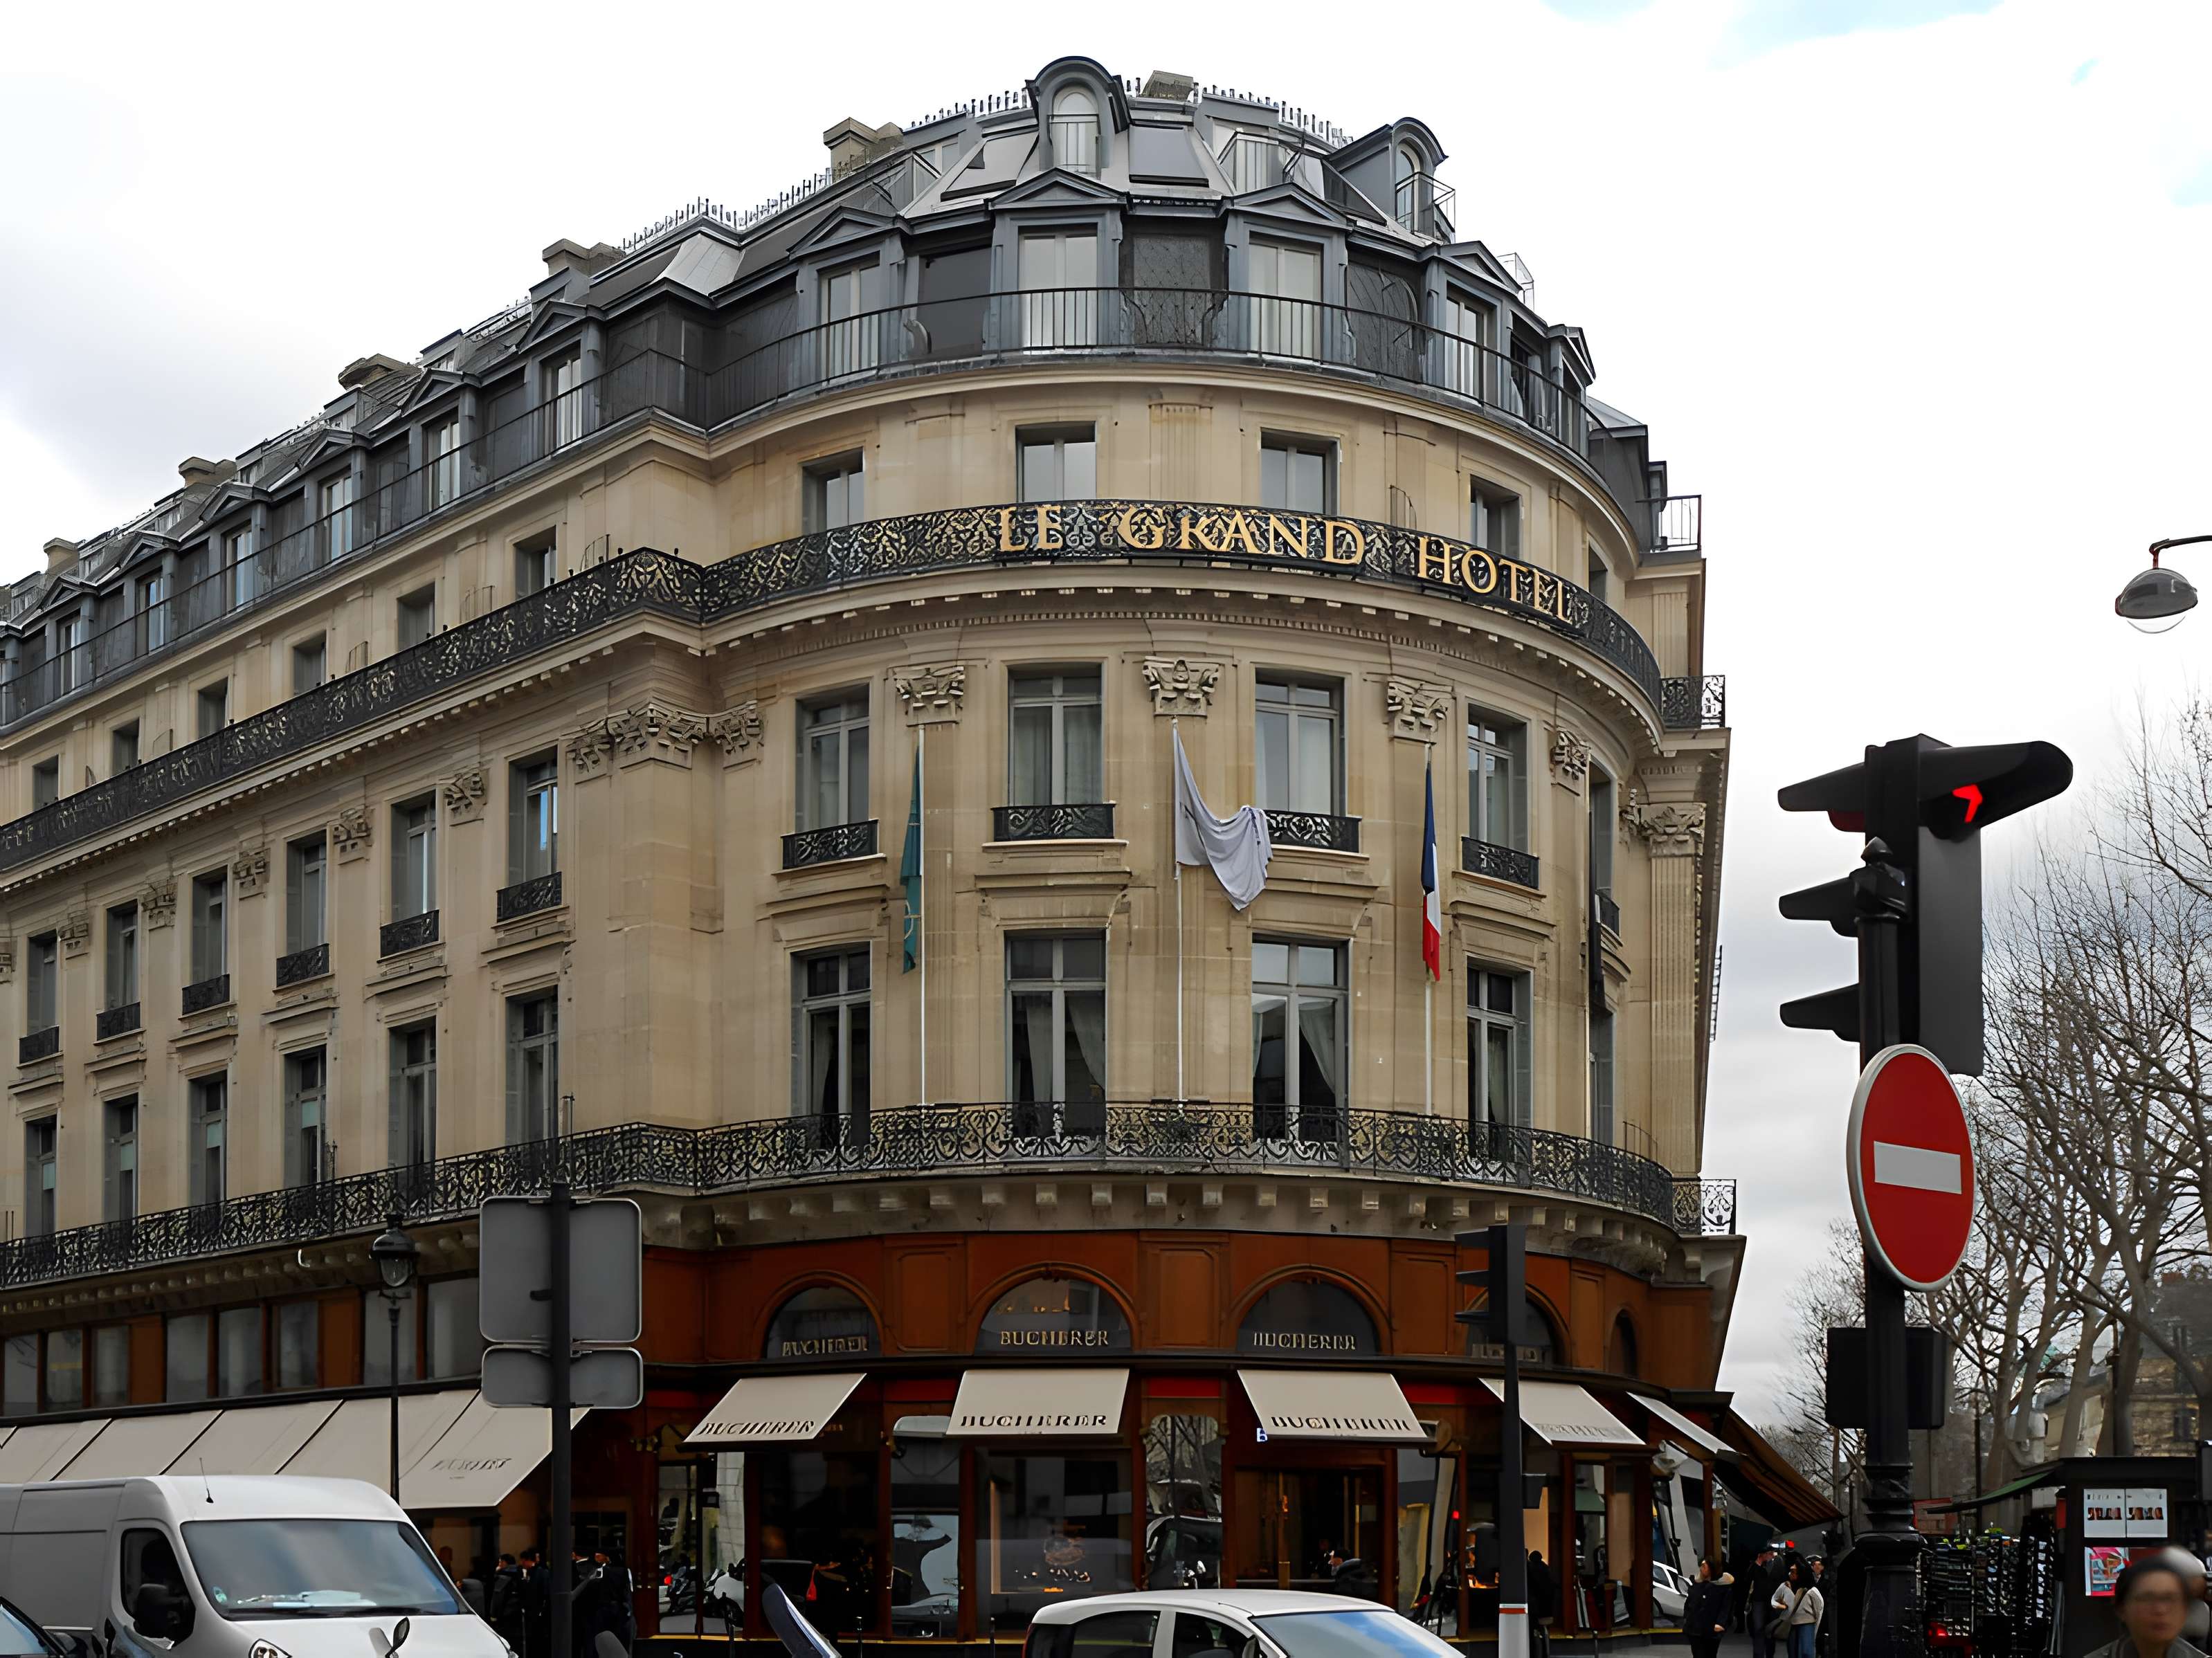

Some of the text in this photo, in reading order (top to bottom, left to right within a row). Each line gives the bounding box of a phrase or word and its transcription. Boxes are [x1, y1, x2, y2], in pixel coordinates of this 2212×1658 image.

[999, 504, 1573, 625] LE GRAND HOTEL
